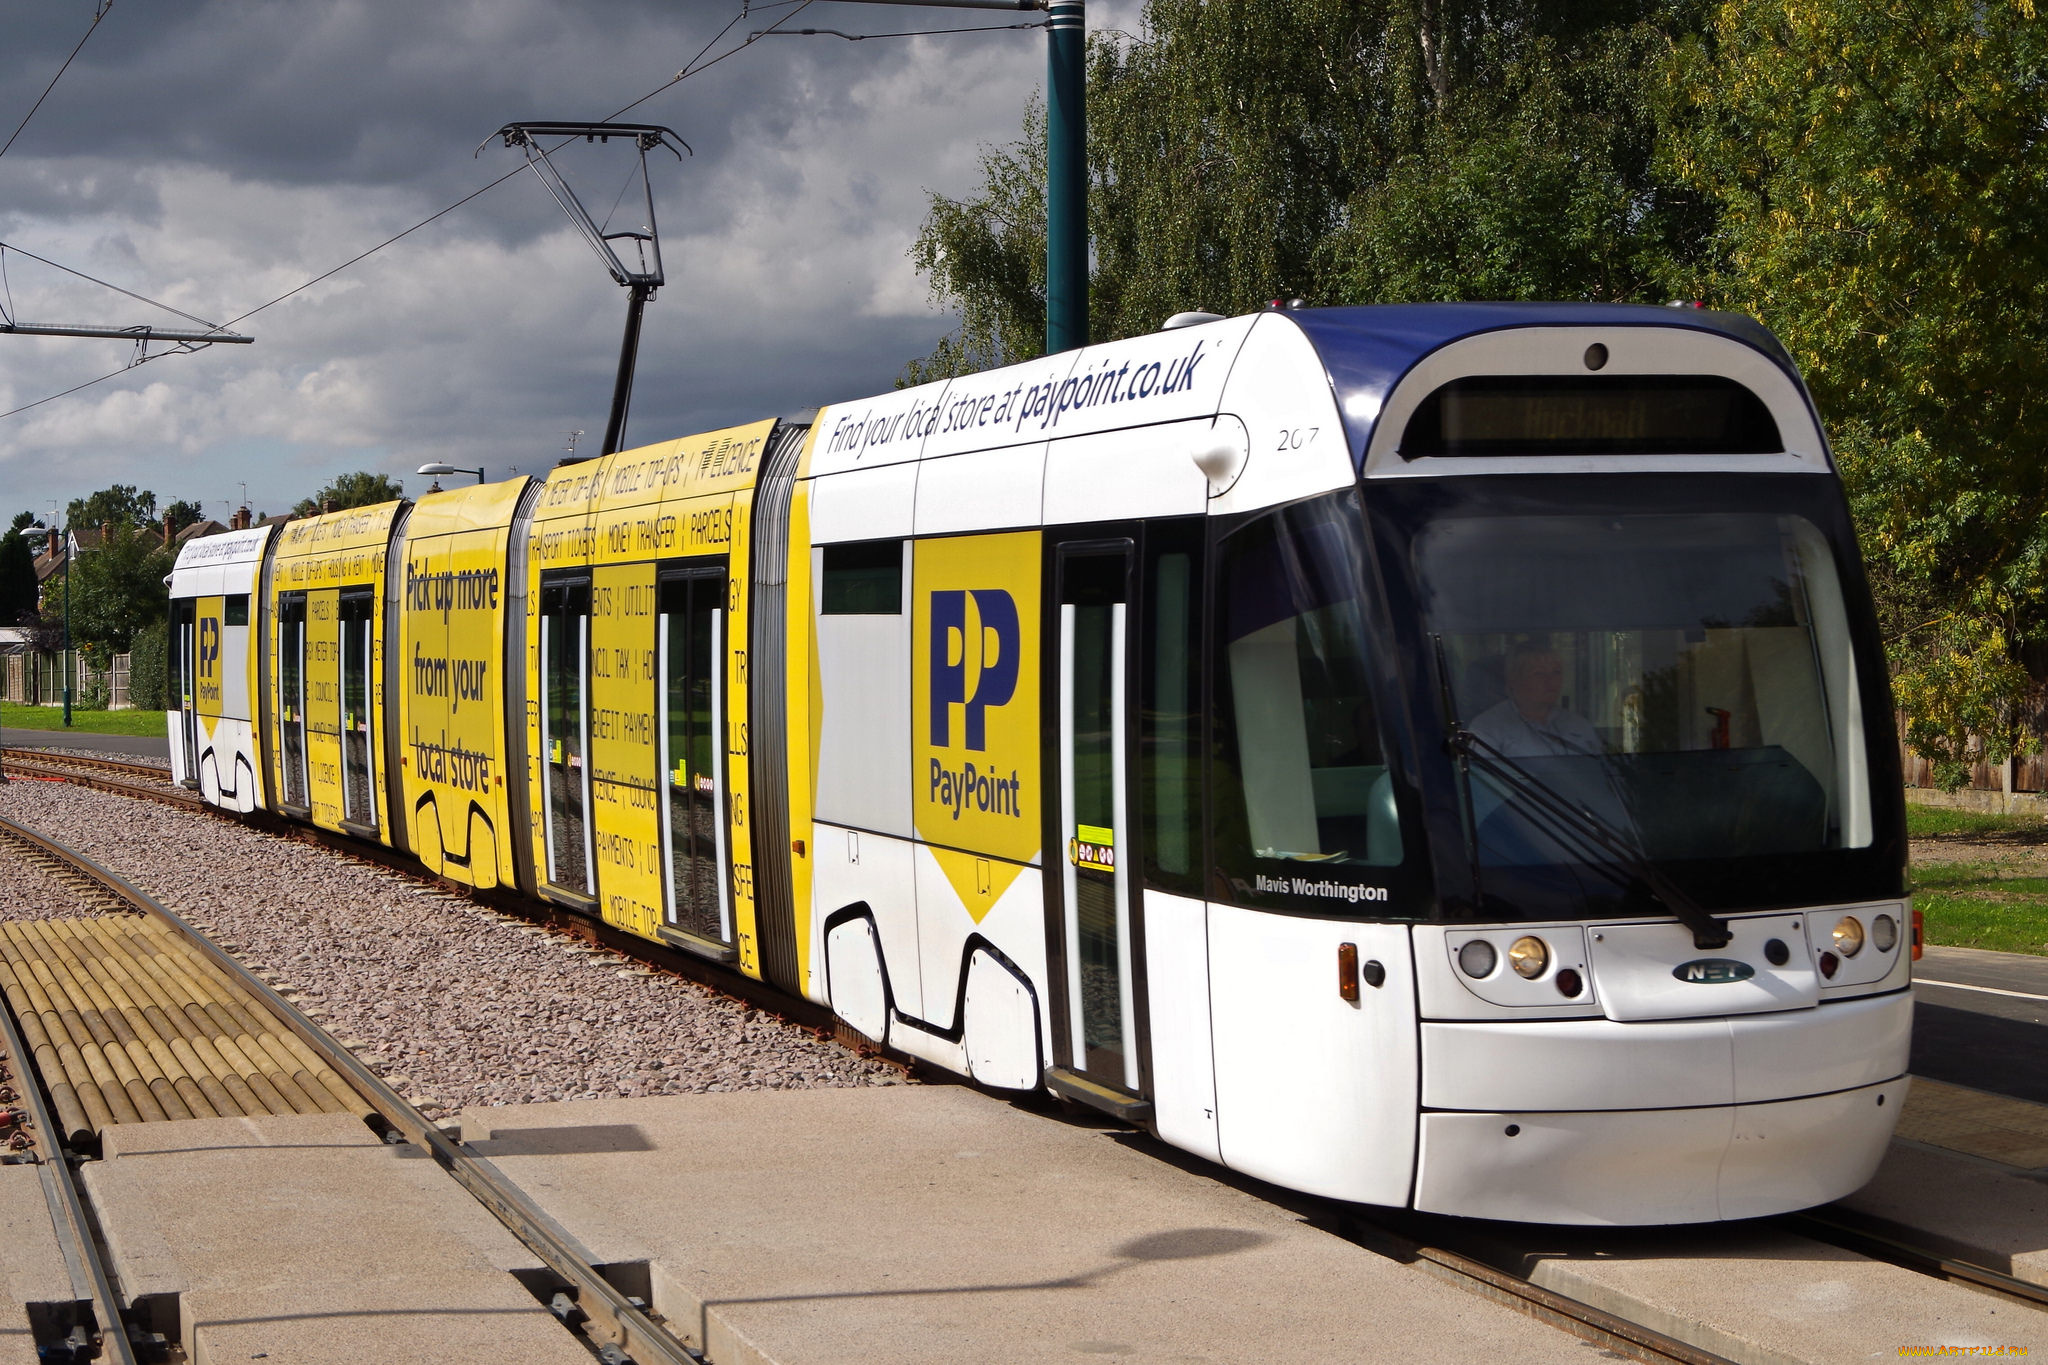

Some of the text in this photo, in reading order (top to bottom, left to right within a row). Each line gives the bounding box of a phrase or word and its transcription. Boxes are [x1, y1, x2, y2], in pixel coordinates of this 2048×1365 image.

[827, 340, 1205, 460] Find your local store at paypoint.co.uk
[1277, 427, 1319, 451] 207
[611, 462, 646, 495] MOBILE
[567, 526, 596, 557] TICKETS
[608, 522, 632, 554] MONEY
[637, 516, 676, 551] TRANSFER
[691, 508, 732, 545] PARCELS
[406, 557, 498, 625] Pick up more
[414, 641, 486, 714] from your
[615, 648, 630, 679] TAX
[200, 681, 220, 704] PayPoint
[415, 725, 447, 784] local
[451, 737, 489, 795] store
[929, 757, 1021, 820] PayPoint
[596, 830, 635, 870] PAYMENTS
[1256, 874, 1388, 903] Mavis Worthington
[610, 895, 637, 932] MOBILE
[1687, 963, 1739, 980] NET
